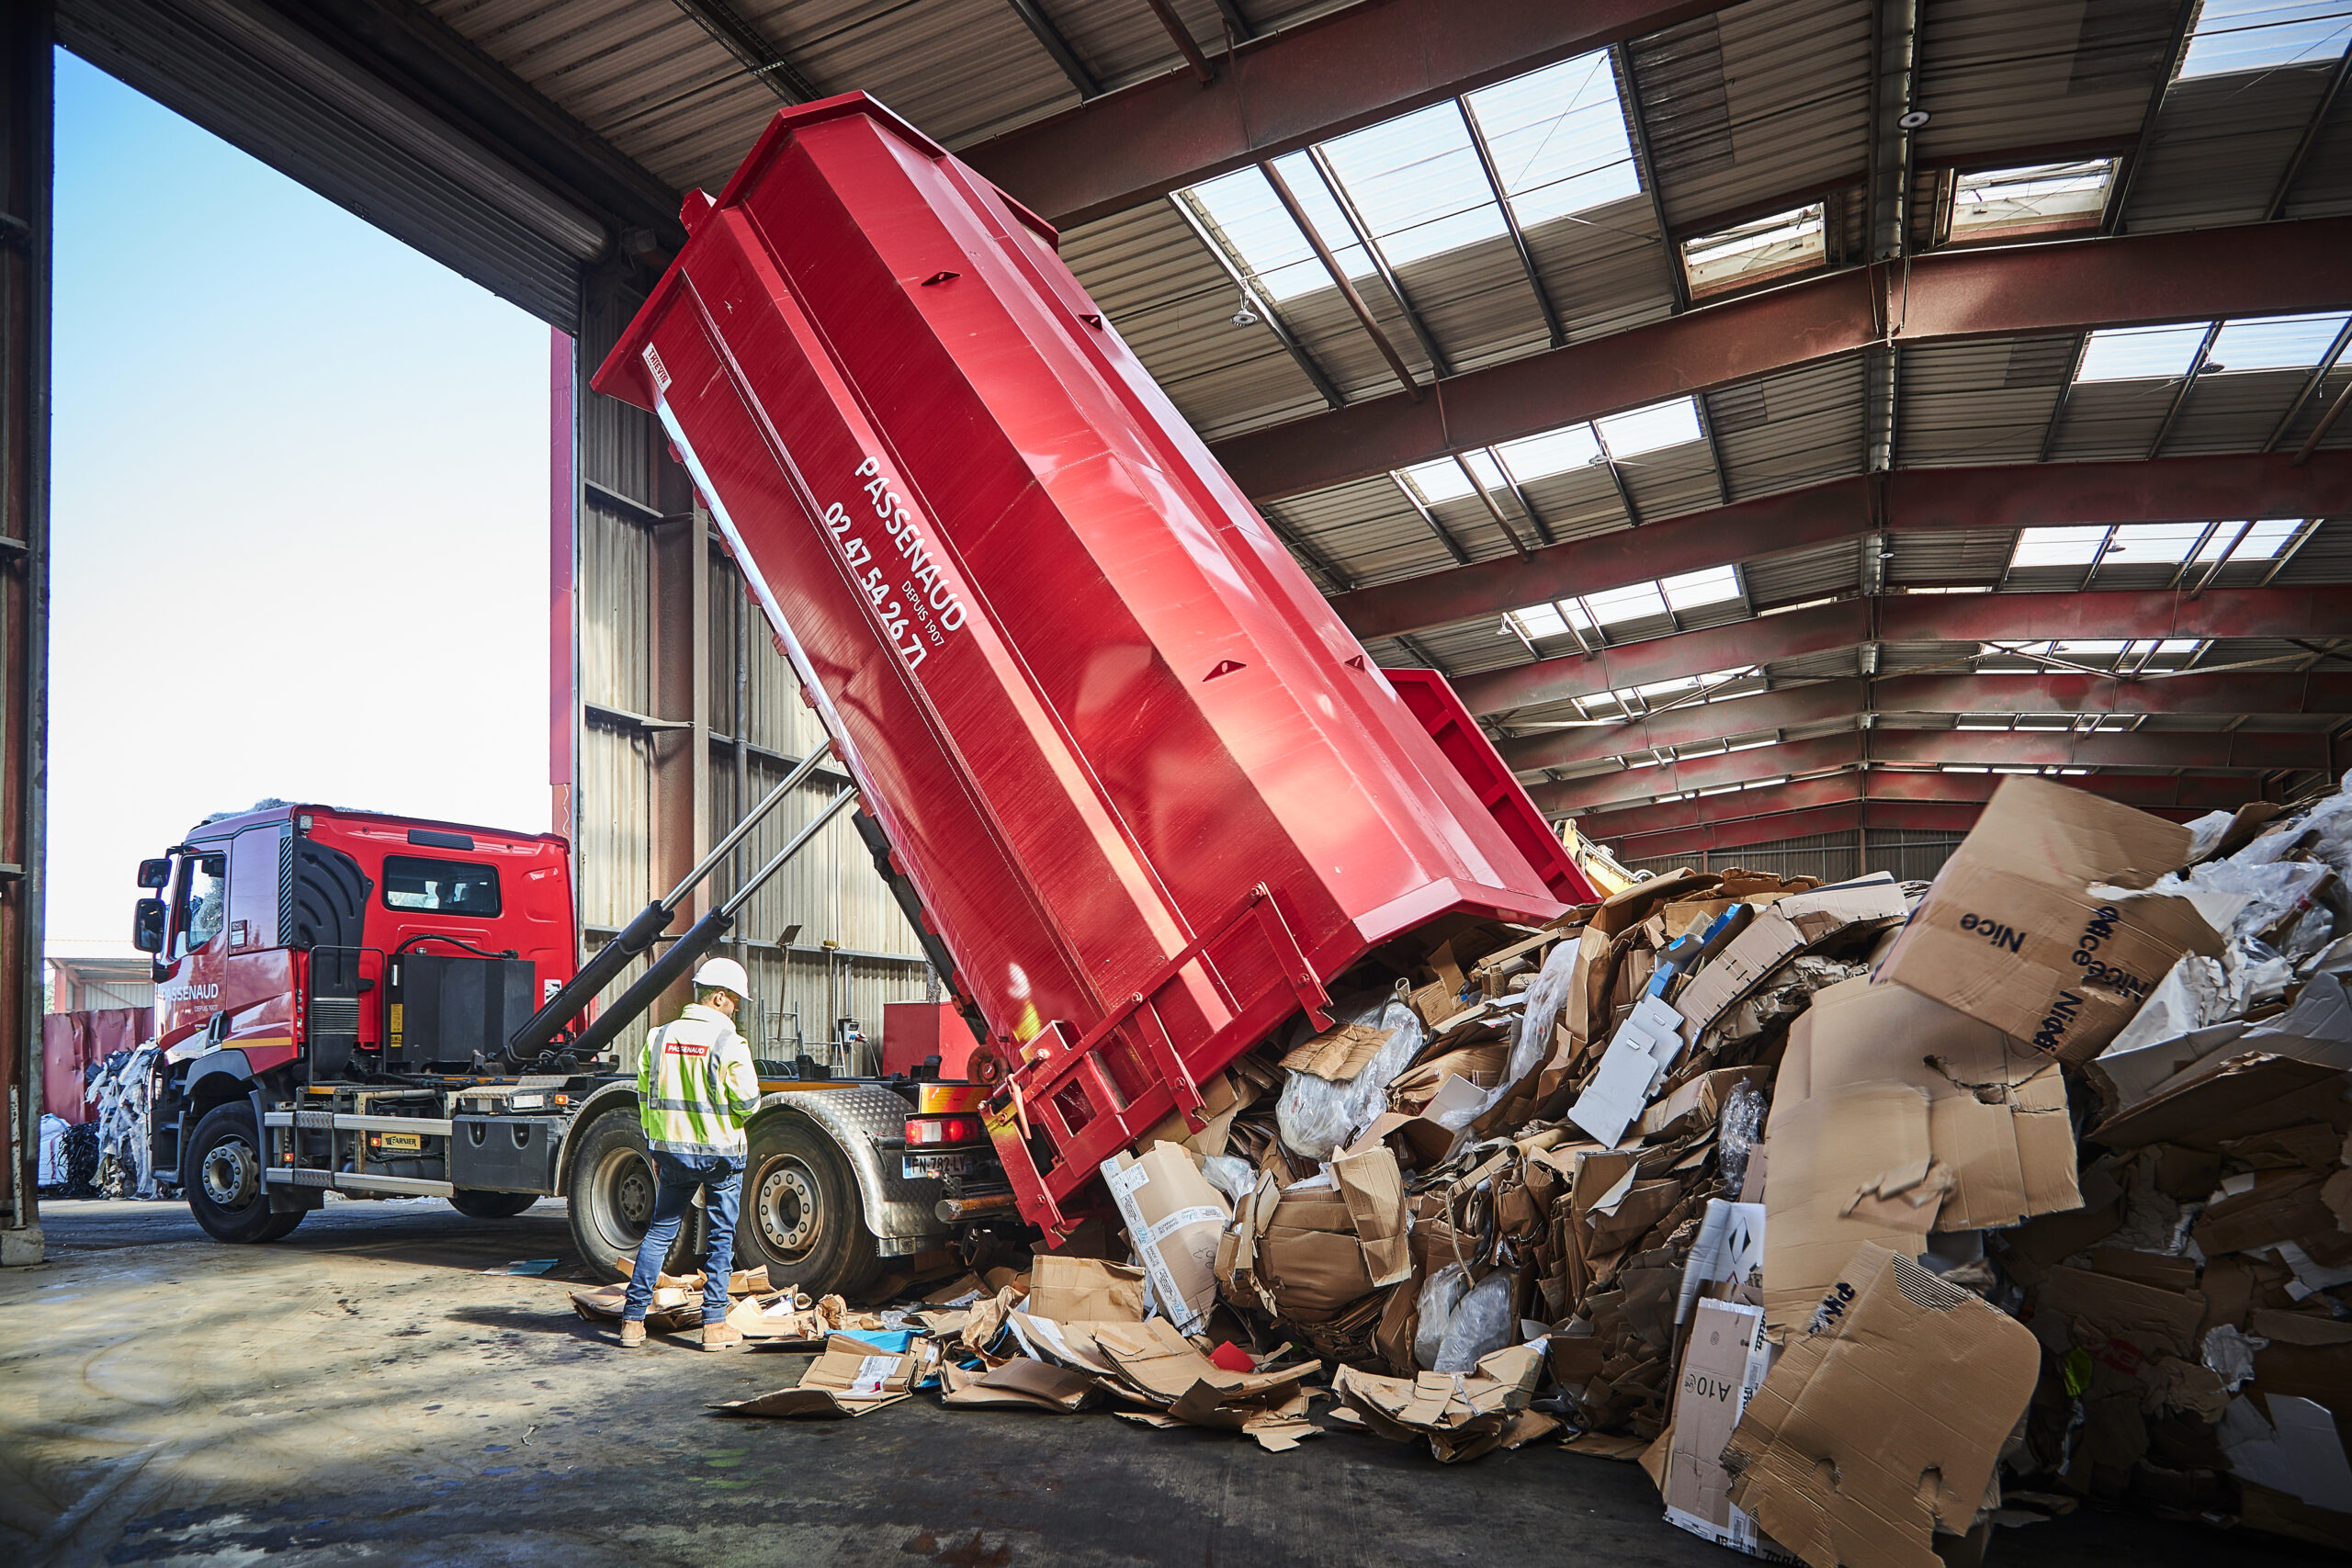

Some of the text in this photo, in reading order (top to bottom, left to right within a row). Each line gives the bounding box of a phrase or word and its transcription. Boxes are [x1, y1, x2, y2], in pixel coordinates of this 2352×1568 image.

[648, 347, 669, 384] THIEVIN
[854, 456, 967, 632] PASSENAUD
[825, 502, 928, 669] 02 47 54 26 71
[901, 581, 945, 647] DEPUIS 1907
[1960, 913, 2027, 953] Nice
[161, 983, 219, 1002] PASSENAUD
[668, 1044, 705, 1055] PASSENAUD
[1697, 1376, 1732, 1403] A10
